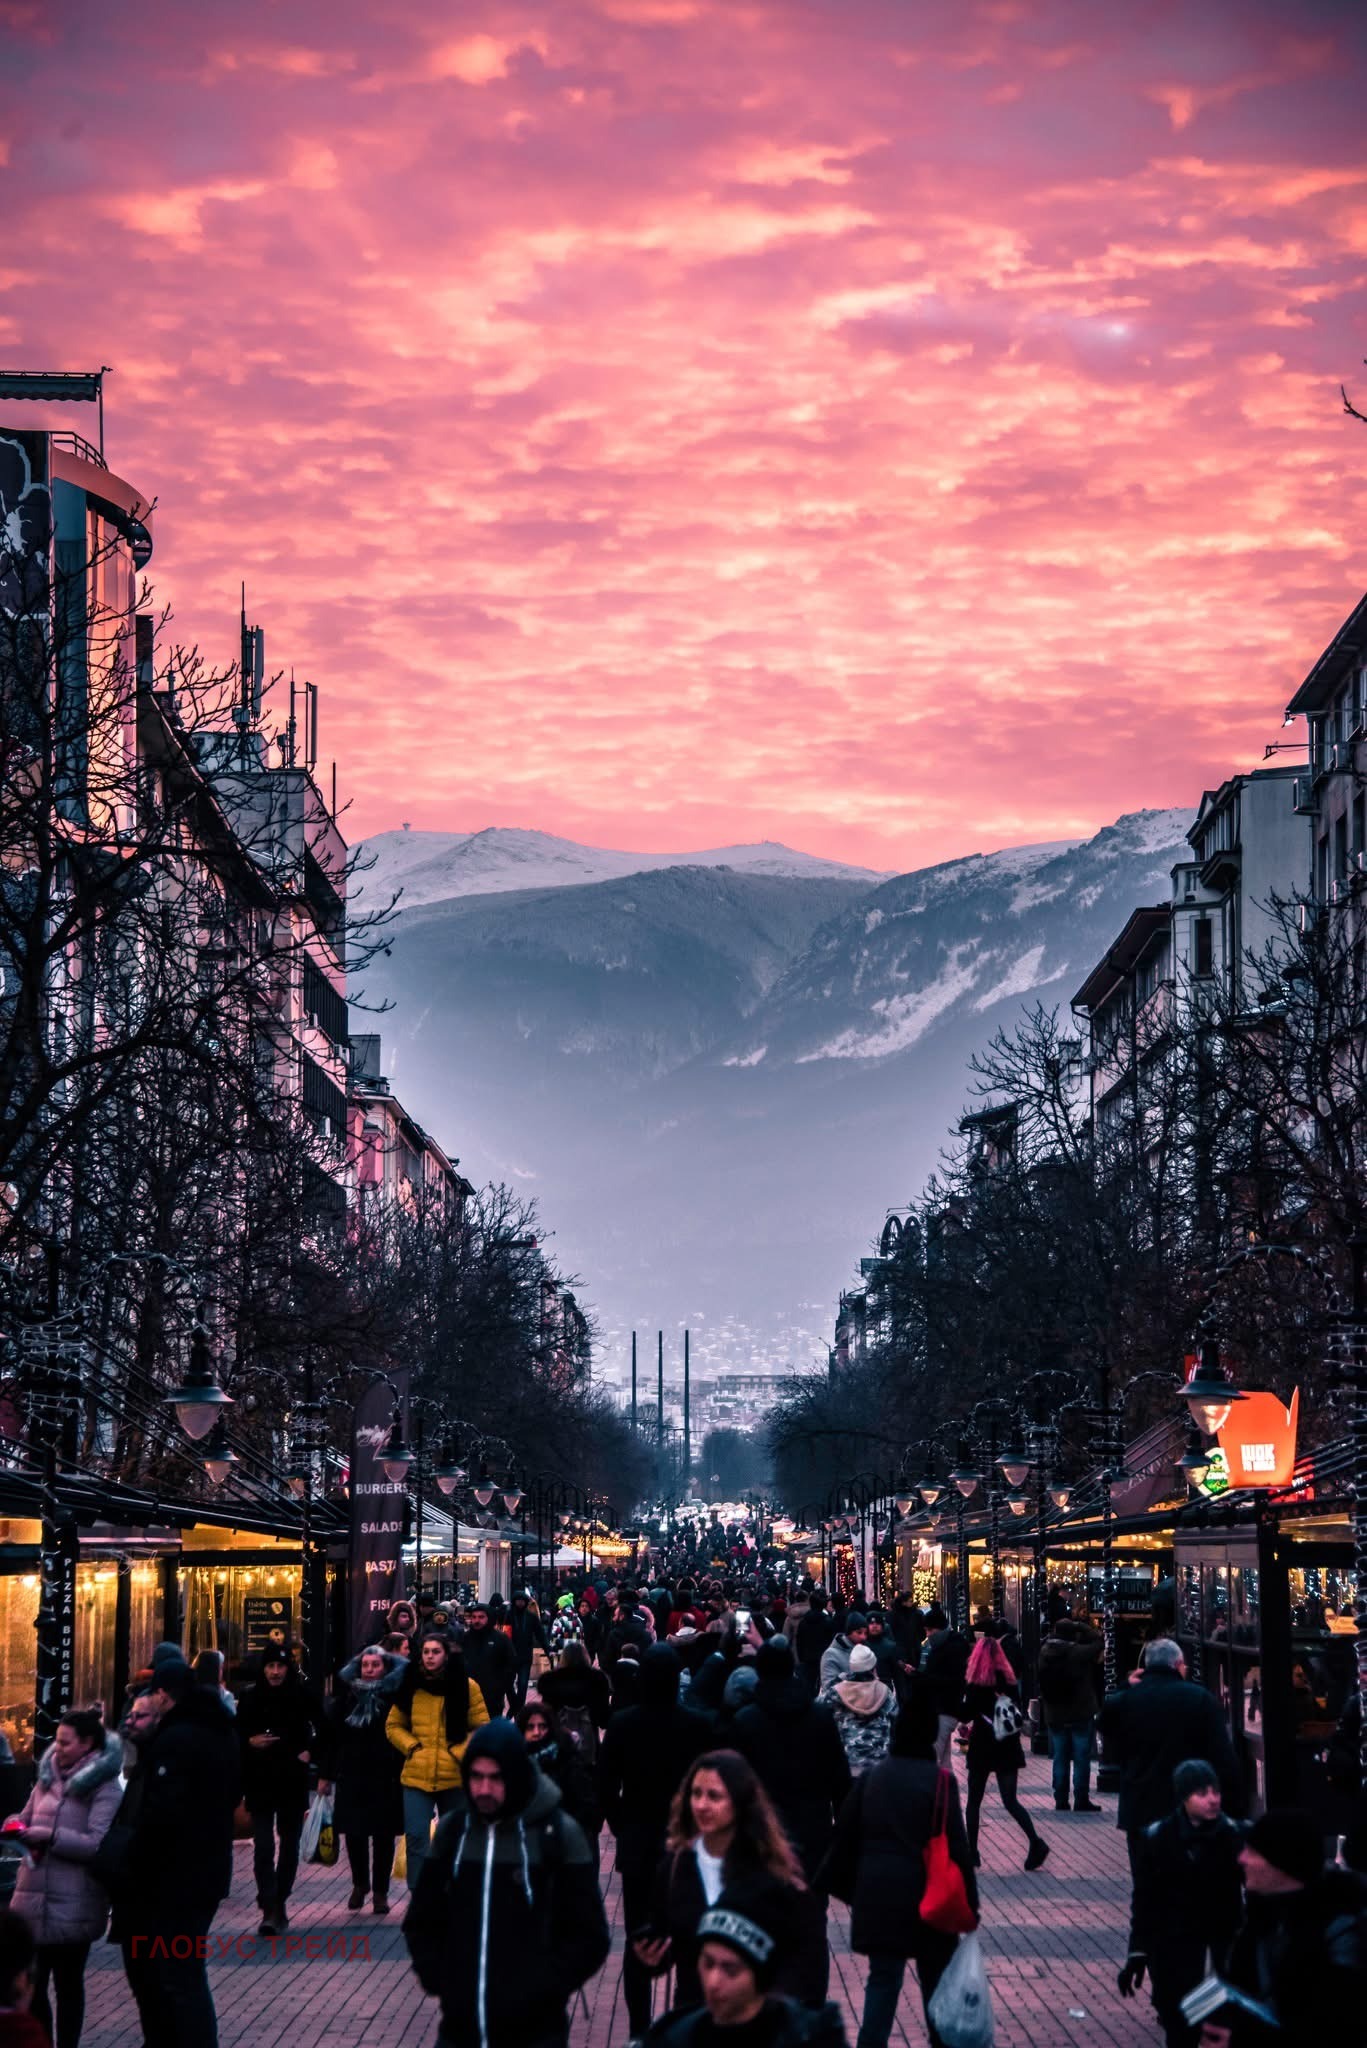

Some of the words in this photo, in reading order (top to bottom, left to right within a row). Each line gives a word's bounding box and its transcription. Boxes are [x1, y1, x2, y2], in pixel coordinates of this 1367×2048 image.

[1240, 1443, 1275, 1461] WOK
[356, 1482, 409, 1495] BURGERS
[62, 1558, 72, 1614] PIZZA
